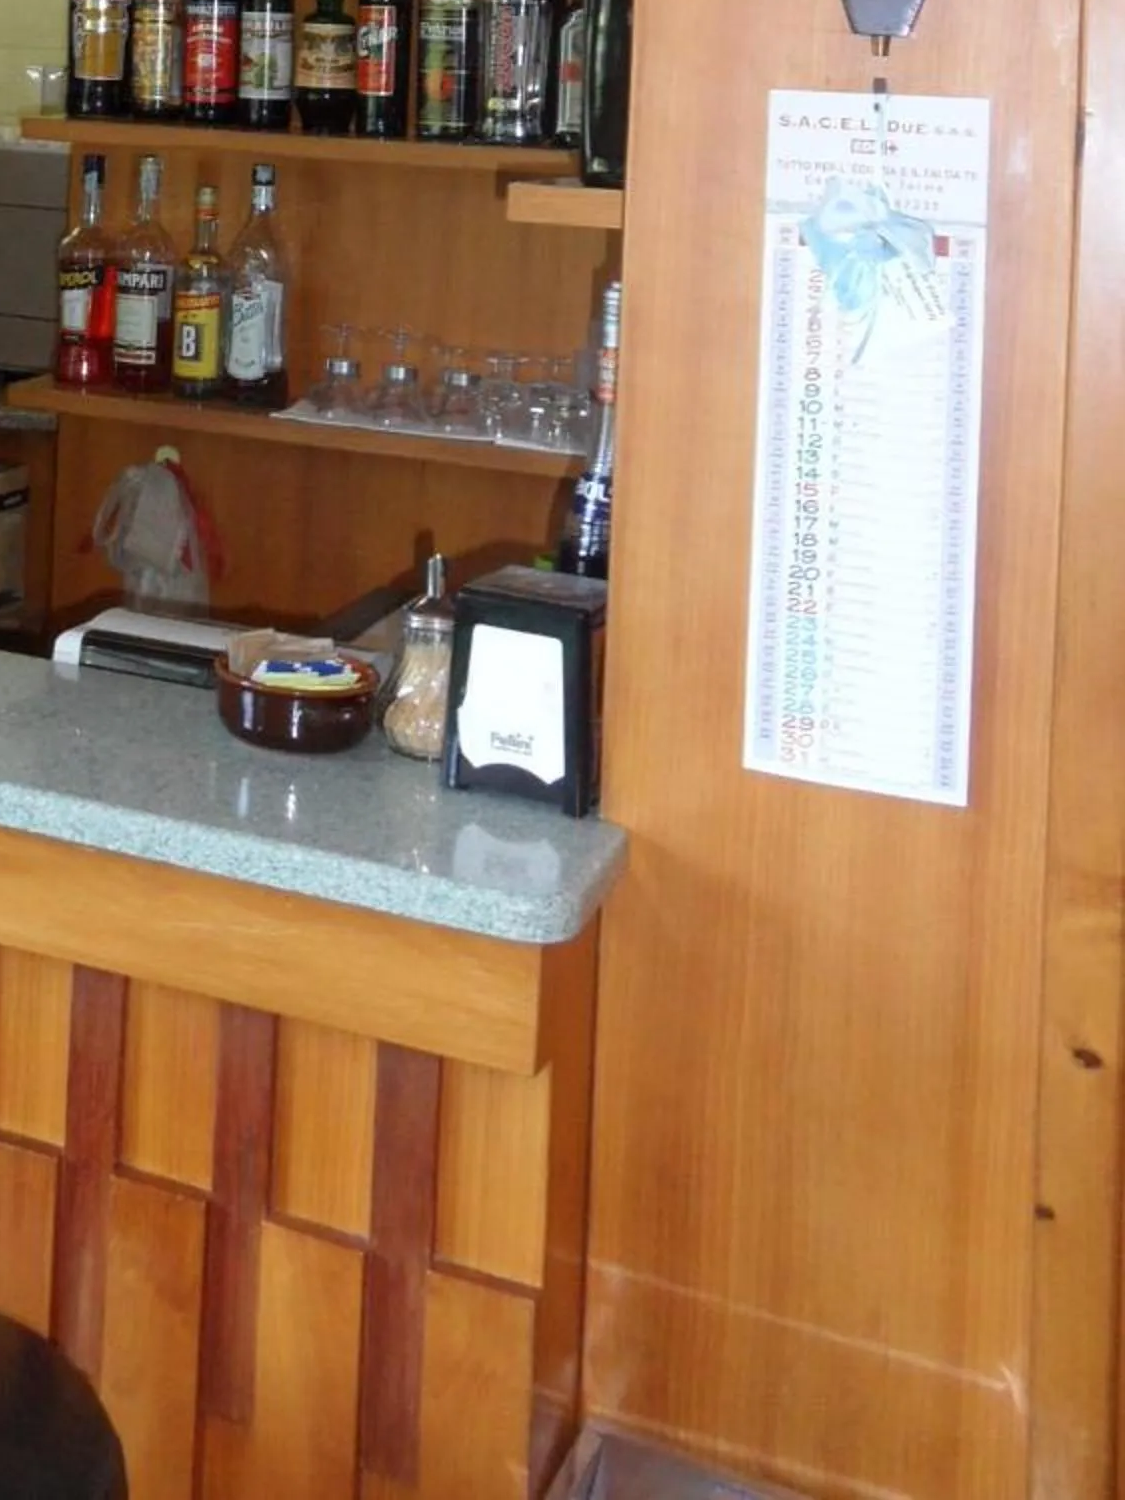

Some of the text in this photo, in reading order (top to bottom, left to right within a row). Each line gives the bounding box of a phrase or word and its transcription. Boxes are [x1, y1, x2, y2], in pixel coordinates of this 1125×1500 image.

[886, 119, 927, 135] DUE
[182, 325, 197, 358] B
[803, 367, 822, 382] 8
[804, 383, 821, 399] 9
[798, 399, 824, 416] 10
[796, 449, 821, 465] 13
[795, 465, 821, 481] 14
[794, 481, 820, 498] 15
[793, 498, 820, 515] 16
[793, 515, 819, 532] 17
[792, 531, 819, 548] 18
[792, 548, 818, 565] 19
[788, 564, 821, 582] 20
[786, 581, 815, 597] 21
[785, 597, 818, 615] 22
[780, 713, 817, 731] 29
